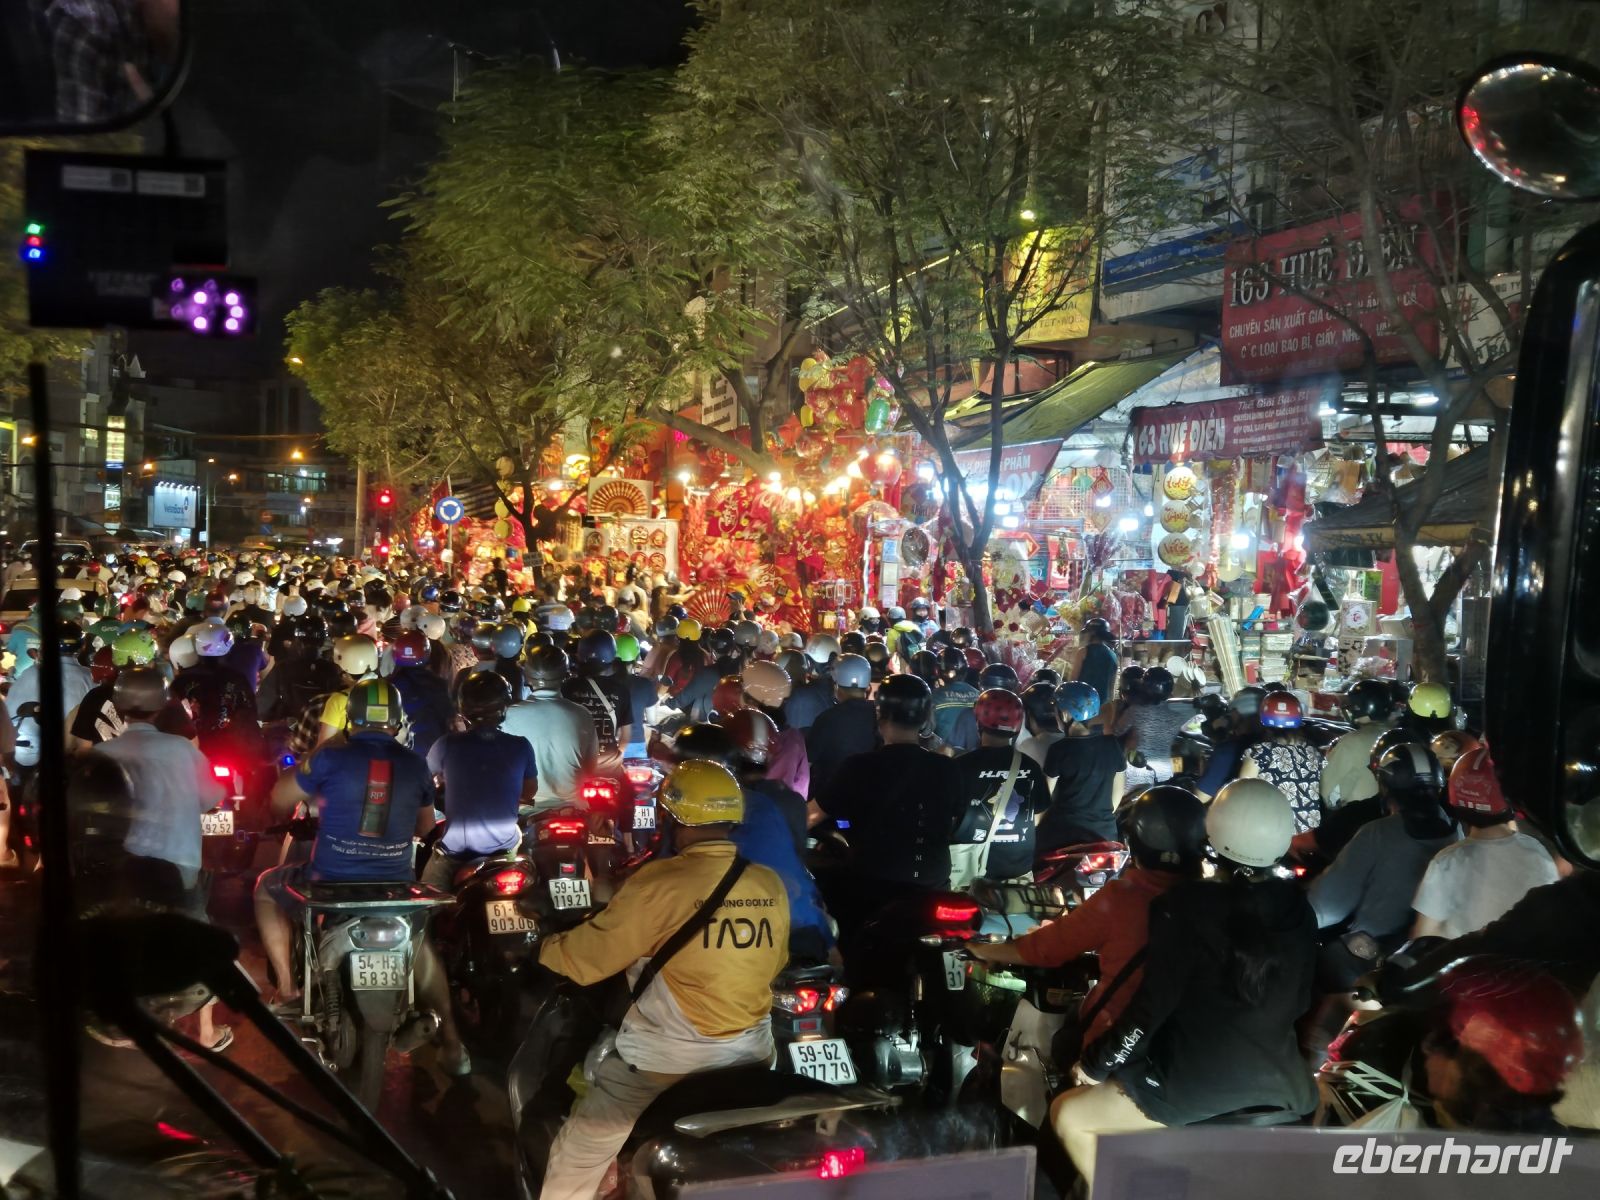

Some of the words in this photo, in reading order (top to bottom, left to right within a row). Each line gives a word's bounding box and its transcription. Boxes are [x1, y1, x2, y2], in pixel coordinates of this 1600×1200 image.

[1229, 262, 1269, 307] 163
[1308, 309, 1328, 322] GIA
[1240, 342, 1257, 359] CC
[1260, 338, 1278, 358] LOẠI
[1281, 336, 1299, 351] BAO
[554, 881, 585, 894] 59-LA
[763, 898, 775, 907] XE
[699, 917, 774, 949] TADA
[359, 955, 397, 969] 54-H3
[360, 971, 398, 986] 5839
[797, 1043, 842, 1063] 59-G2
